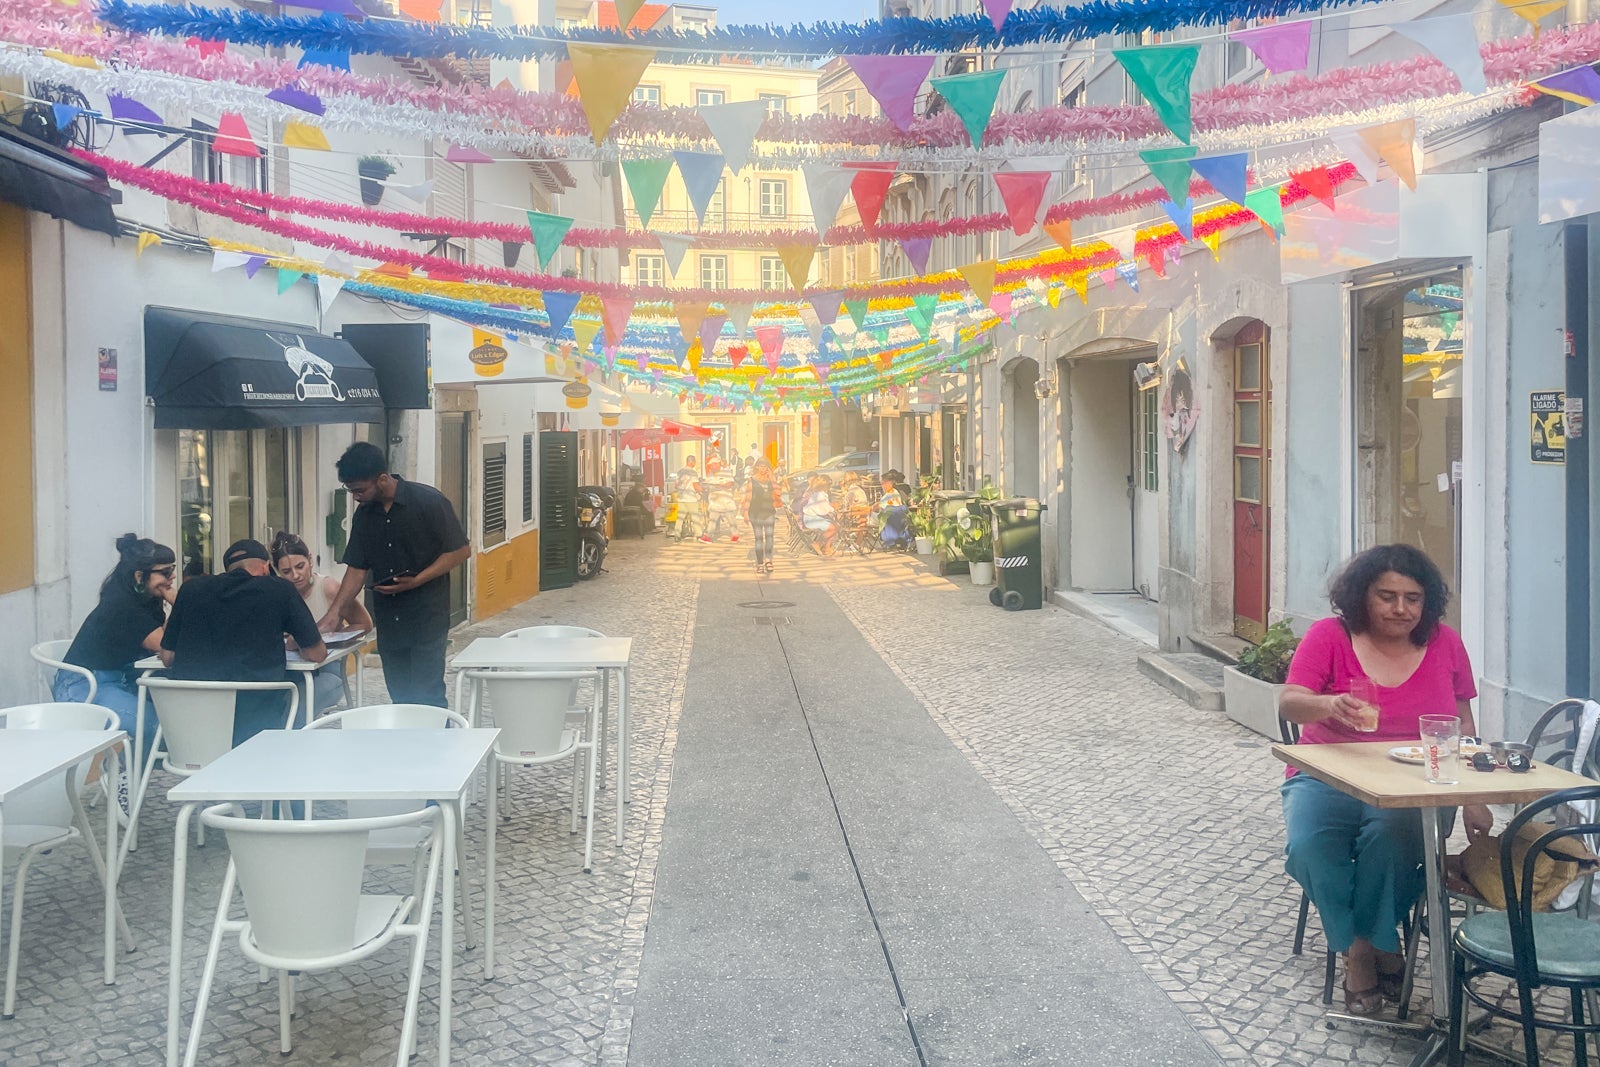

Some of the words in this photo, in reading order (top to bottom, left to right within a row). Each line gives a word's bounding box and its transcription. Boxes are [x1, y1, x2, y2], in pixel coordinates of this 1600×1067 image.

[1532, 393, 1556, 401] ALARME
[1532, 401, 1557, 409] LIGADO
[1430, 745, 1440, 770] SAGRES
